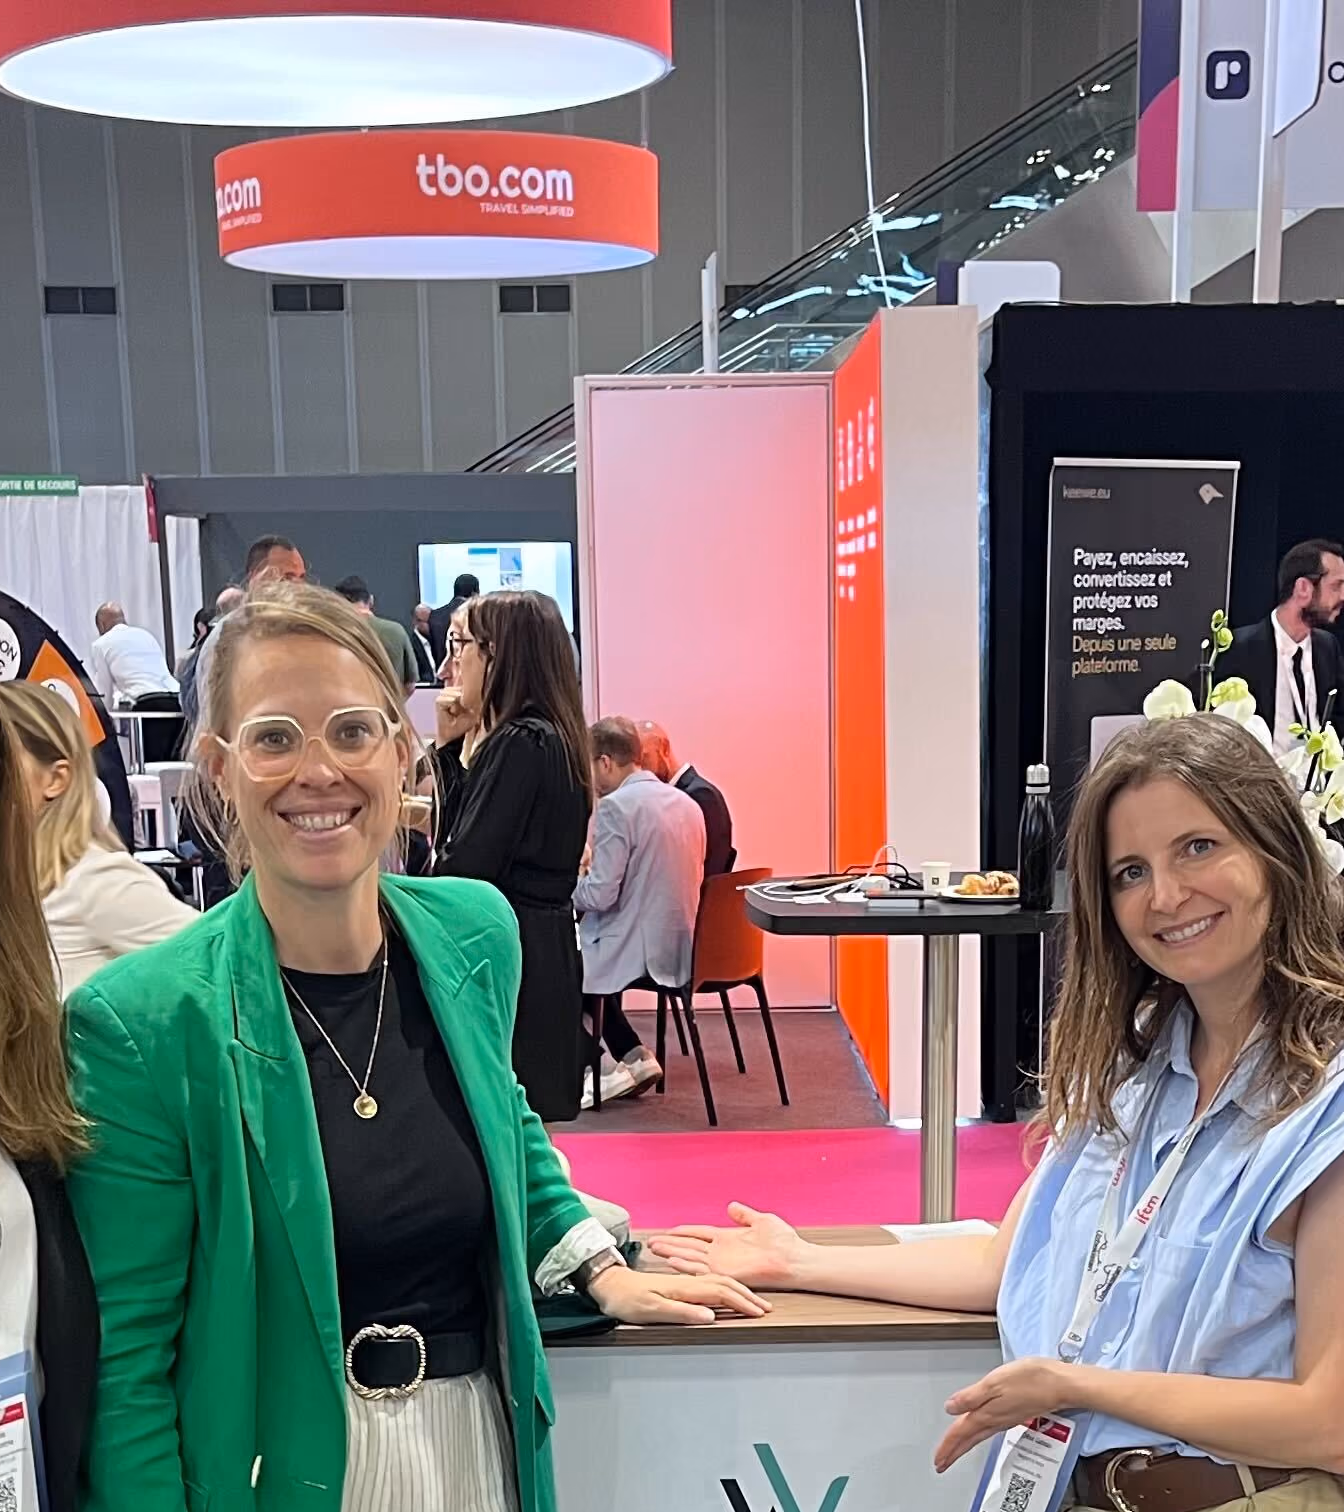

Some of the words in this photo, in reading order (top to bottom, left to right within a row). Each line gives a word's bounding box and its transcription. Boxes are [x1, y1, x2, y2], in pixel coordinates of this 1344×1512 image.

[416, 154, 574, 201] tbo.com
[480, 202, 519, 214] TRAVEL
[522, 204, 574, 217] SIMPLIFIED
[24, 480, 36, 491] DE
[38, 480, 77, 491] SECOURS
[1073, 548, 1117, 569] Payez,
[1120, 548, 1189, 568] encaissez,
[1073, 570, 1156, 588] convertissez
[1158, 571, 1172, 587] et
[1073, 591, 1132, 613] protégez
[1135, 595, 1158, 608] vos
[1073, 617, 1125, 634] marges.
[1073, 635, 1115, 656] Depuis
[1118, 639, 1142, 652] une
[1144, 634, 1177, 650] seule
[1072, 657, 1141, 678] plateforme.
